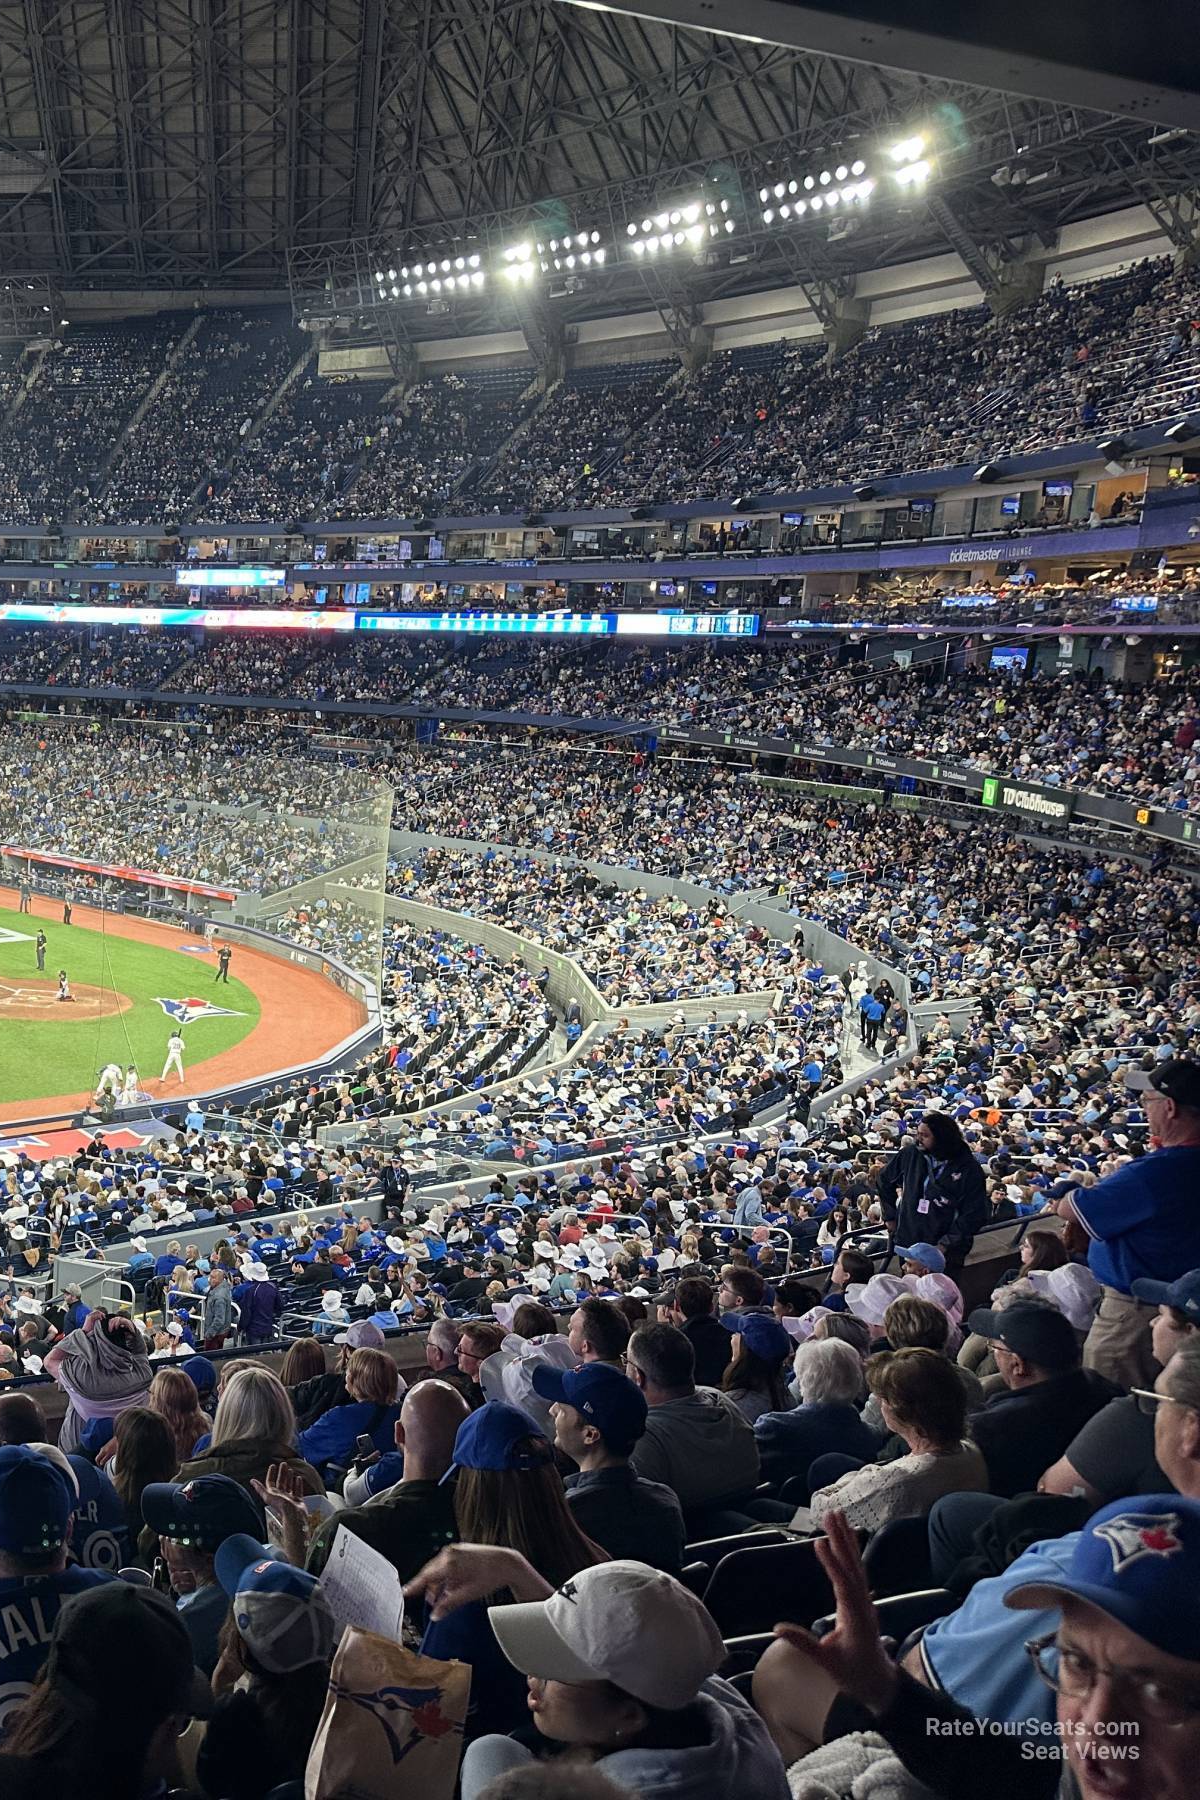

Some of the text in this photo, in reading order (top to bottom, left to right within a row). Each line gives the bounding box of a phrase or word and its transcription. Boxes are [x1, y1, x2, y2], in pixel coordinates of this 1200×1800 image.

[949, 547, 1002, 563] ticketmaster
[1003, 787, 1066, 818] TD Clubhouse
